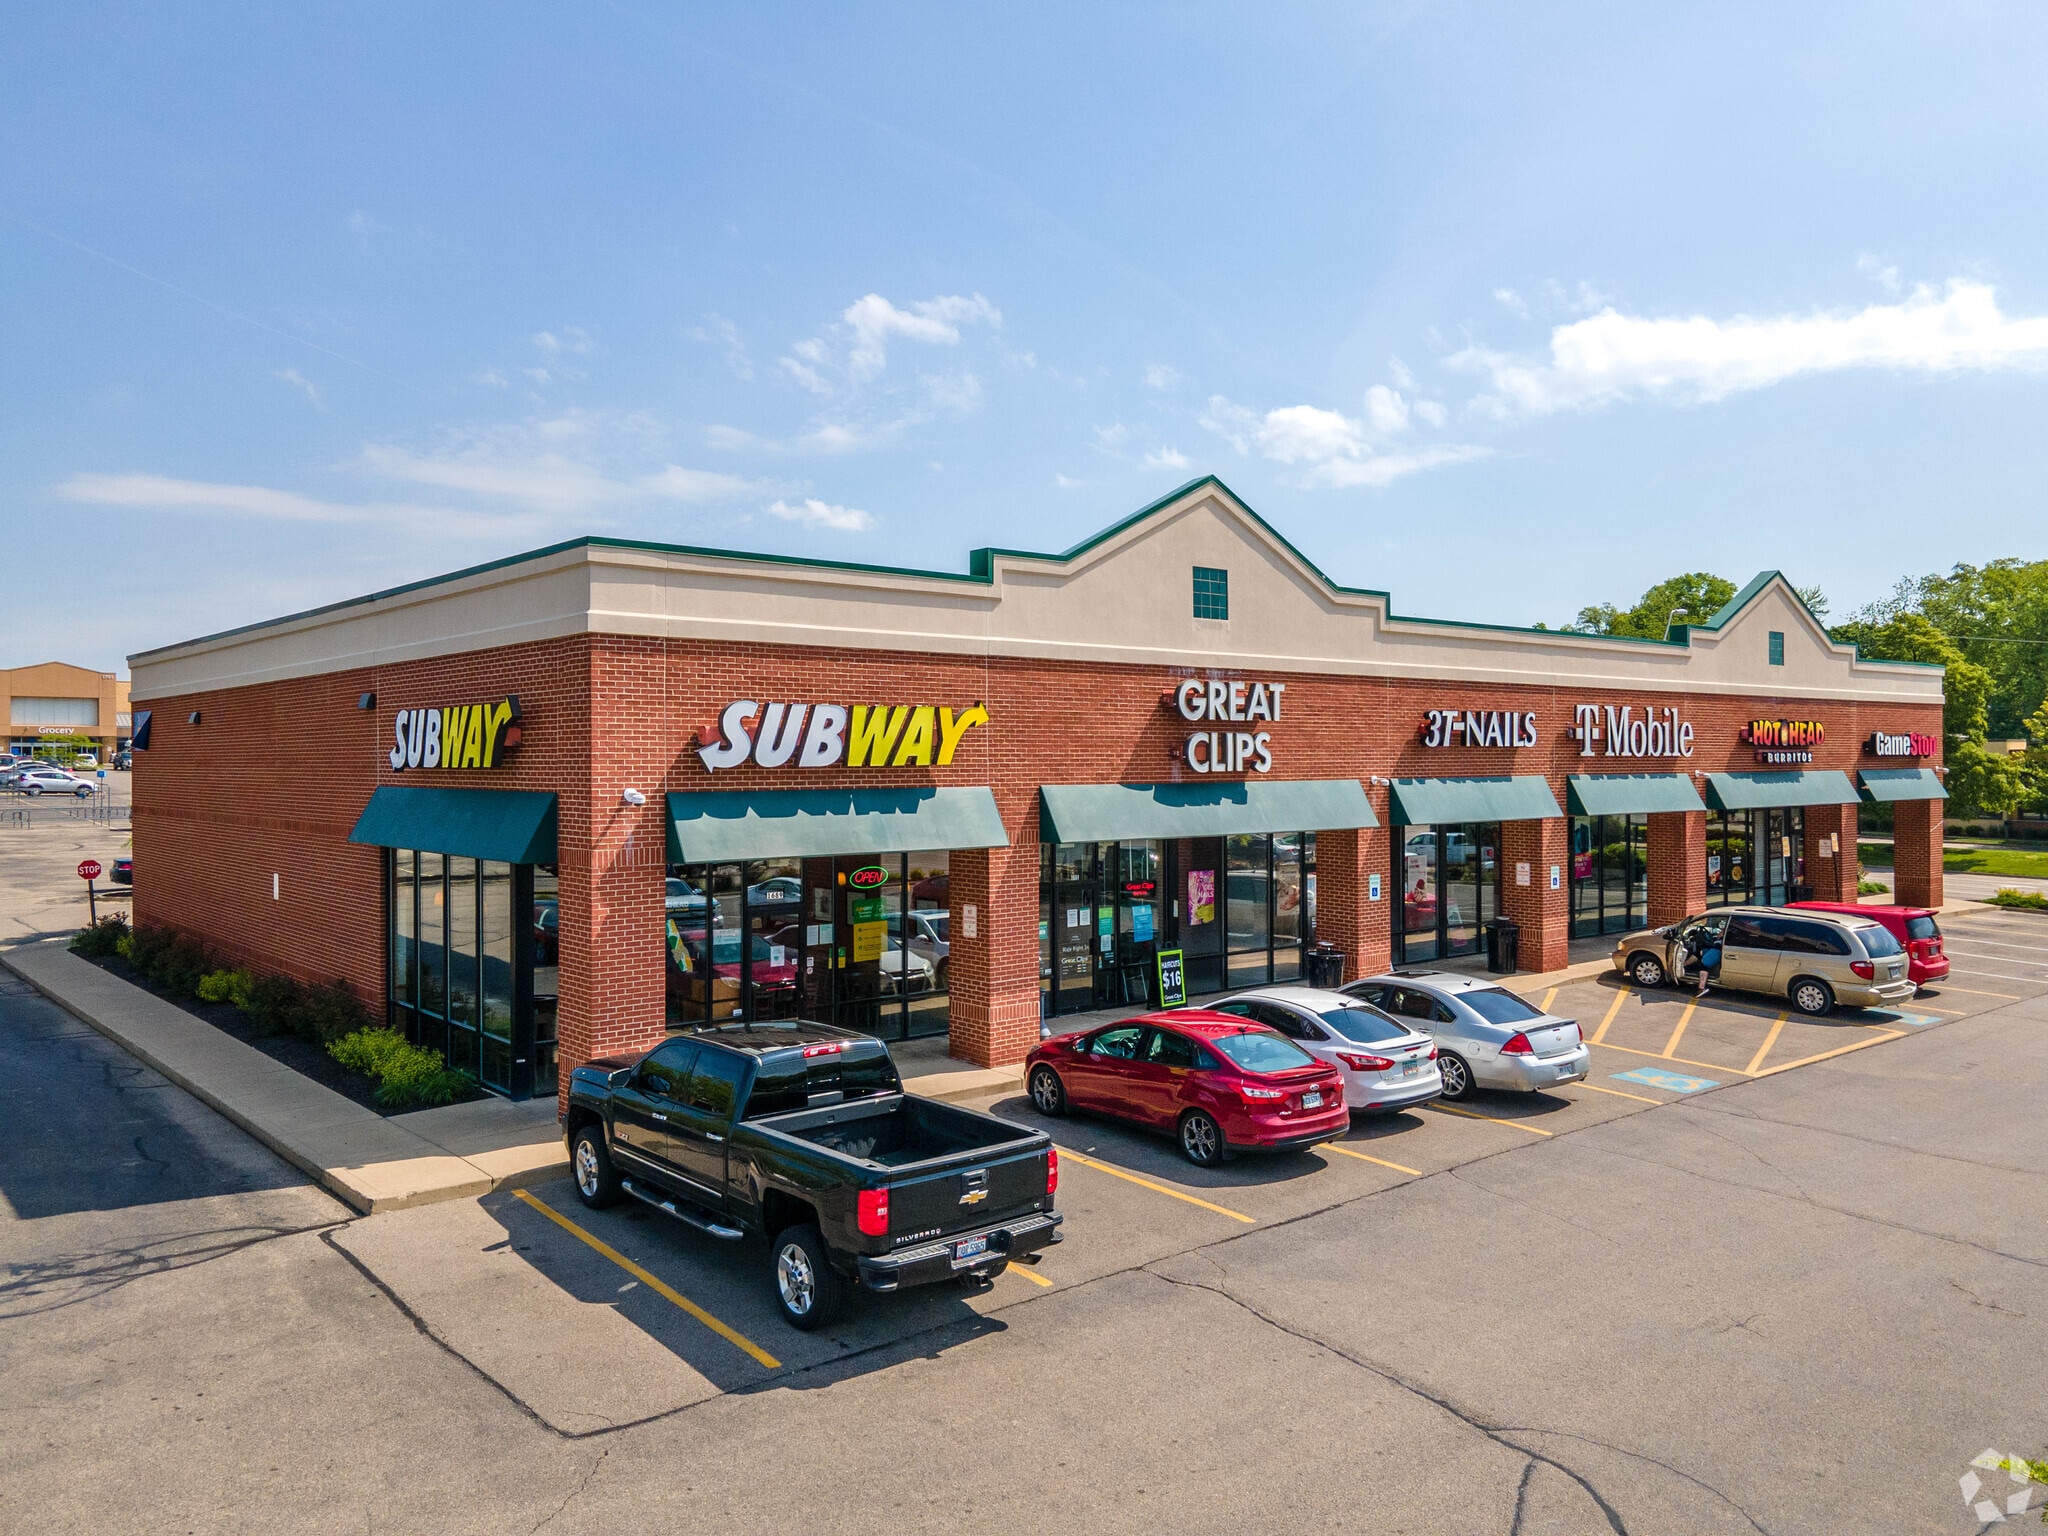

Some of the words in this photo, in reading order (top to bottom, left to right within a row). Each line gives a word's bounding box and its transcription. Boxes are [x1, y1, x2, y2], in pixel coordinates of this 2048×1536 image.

[1178, 679, 1285, 721] GREAT
[38, 726, 75, 735] Grocery
[389, 697, 513, 769] SUBWAY
[699, 700, 990, 774] SUBWAY
[1425, 709, 1537, 748] 3T-NAILS
[1753, 719, 1781, 746] HOT
[1789, 720, 1825, 746] HEAD
[1188, 731, 1272, 773] CLIPS
[1767, 751, 1813, 763] BURRITOS
[1876, 731, 1938, 758] GameStop
[78, 865, 101, 875] STOP
[854, 871, 883, 884] OPEN
[1162, 970, 1181, 990] $16
